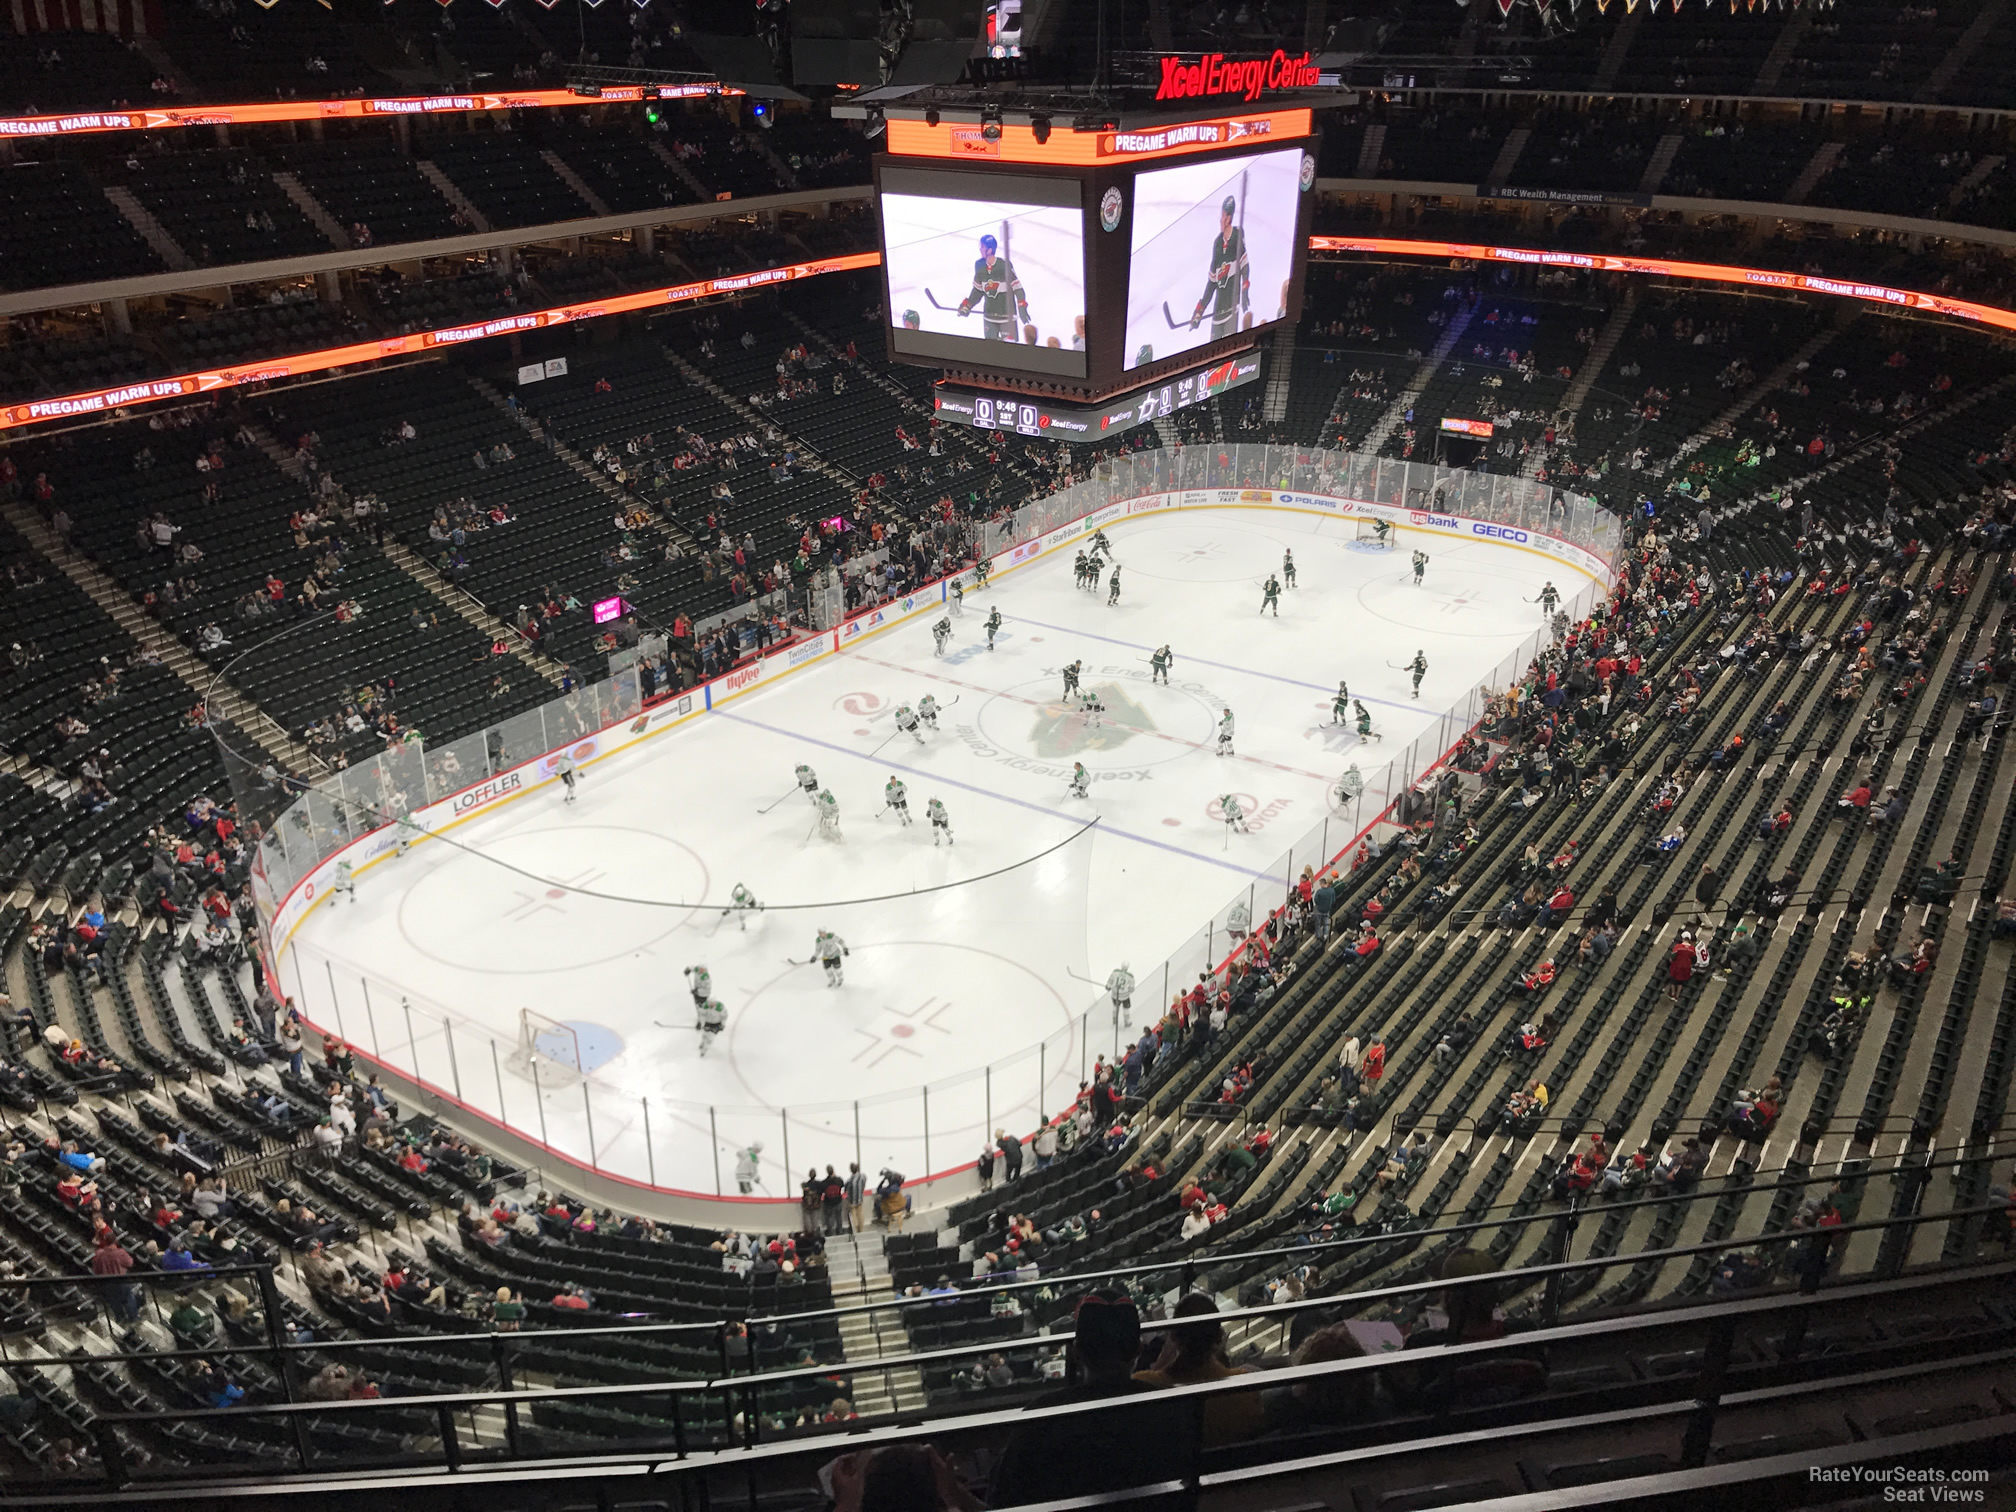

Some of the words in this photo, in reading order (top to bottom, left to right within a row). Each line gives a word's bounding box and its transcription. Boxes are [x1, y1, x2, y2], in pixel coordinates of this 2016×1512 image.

[1155, 54, 1209, 100] Xcel
[1206, 54, 1268, 101] Energy
[602, 91, 633, 99] TOASTY
[374, 101, 422, 112] PREGAME
[424, 99, 452, 110] WARM
[454, 98, 473, 108] UPS
[59, 116, 101, 130] WARM
[103, 116, 130, 127] UPS
[1115, 134, 1165, 151] PREGAME
[1167, 127, 1198, 146] WARM
[1199, 125, 1218, 142] UPS
[1501, 188, 1517, 197] RBC
[1519, 189, 1547, 199] Wealth
[1549, 191, 1602, 202] Management
[1496, 249, 1540, 262] PREGAME
[1542, 253, 1571, 263] WARM
[1573, 256, 1593, 266] UPS
[713, 276, 749, 290] PREGAME
[749, 273, 772, 284] WARM
[773, 271, 787, 279] UPS
[1745, 272, 1787, 284] TOASTY
[667, 289, 699, 299] TOASTY
[1805, 278, 1853, 295] PREGAME
[1855, 286, 1884, 298] WARM
[1886, 291, 1905, 303] UPS
[435, 327, 484, 342] PREGAME
[486, 321, 516, 334] WARM
[517, 316, 537, 328] UPS
[1178, 378, 1193, 394] 9:48
[1201, 375, 1206, 390] 0
[30, 397, 104, 417] PREGAME
[106, 386, 151, 406] WARM
[153, 382, 182, 396] UPS
[1162, 389, 1168, 405] 0
[941, 402, 955, 411] Xcel
[955, 404, 974, 415] Energy
[979, 402, 990, 418] 0
[996, 400, 1017, 412] 9:48
[1000, 412, 1012, 420] 1ST
[1022, 408, 1034, 426] 0
[1051, 418, 1067, 427] Xcel
[1066, 421, 1088, 432] Energy
[1295, 496, 1337, 508] POLARIS
[1356, 505, 1373, 514] Xcel
[1373, 508, 1398, 518] Energy
[1411, 515, 1426, 523] us
[1427, 515, 1458, 529] bank
[1472, 523, 1528, 543] GEICO
[788, 640, 823, 659] TwinCities
[453, 773, 520, 812] LOFFLER
